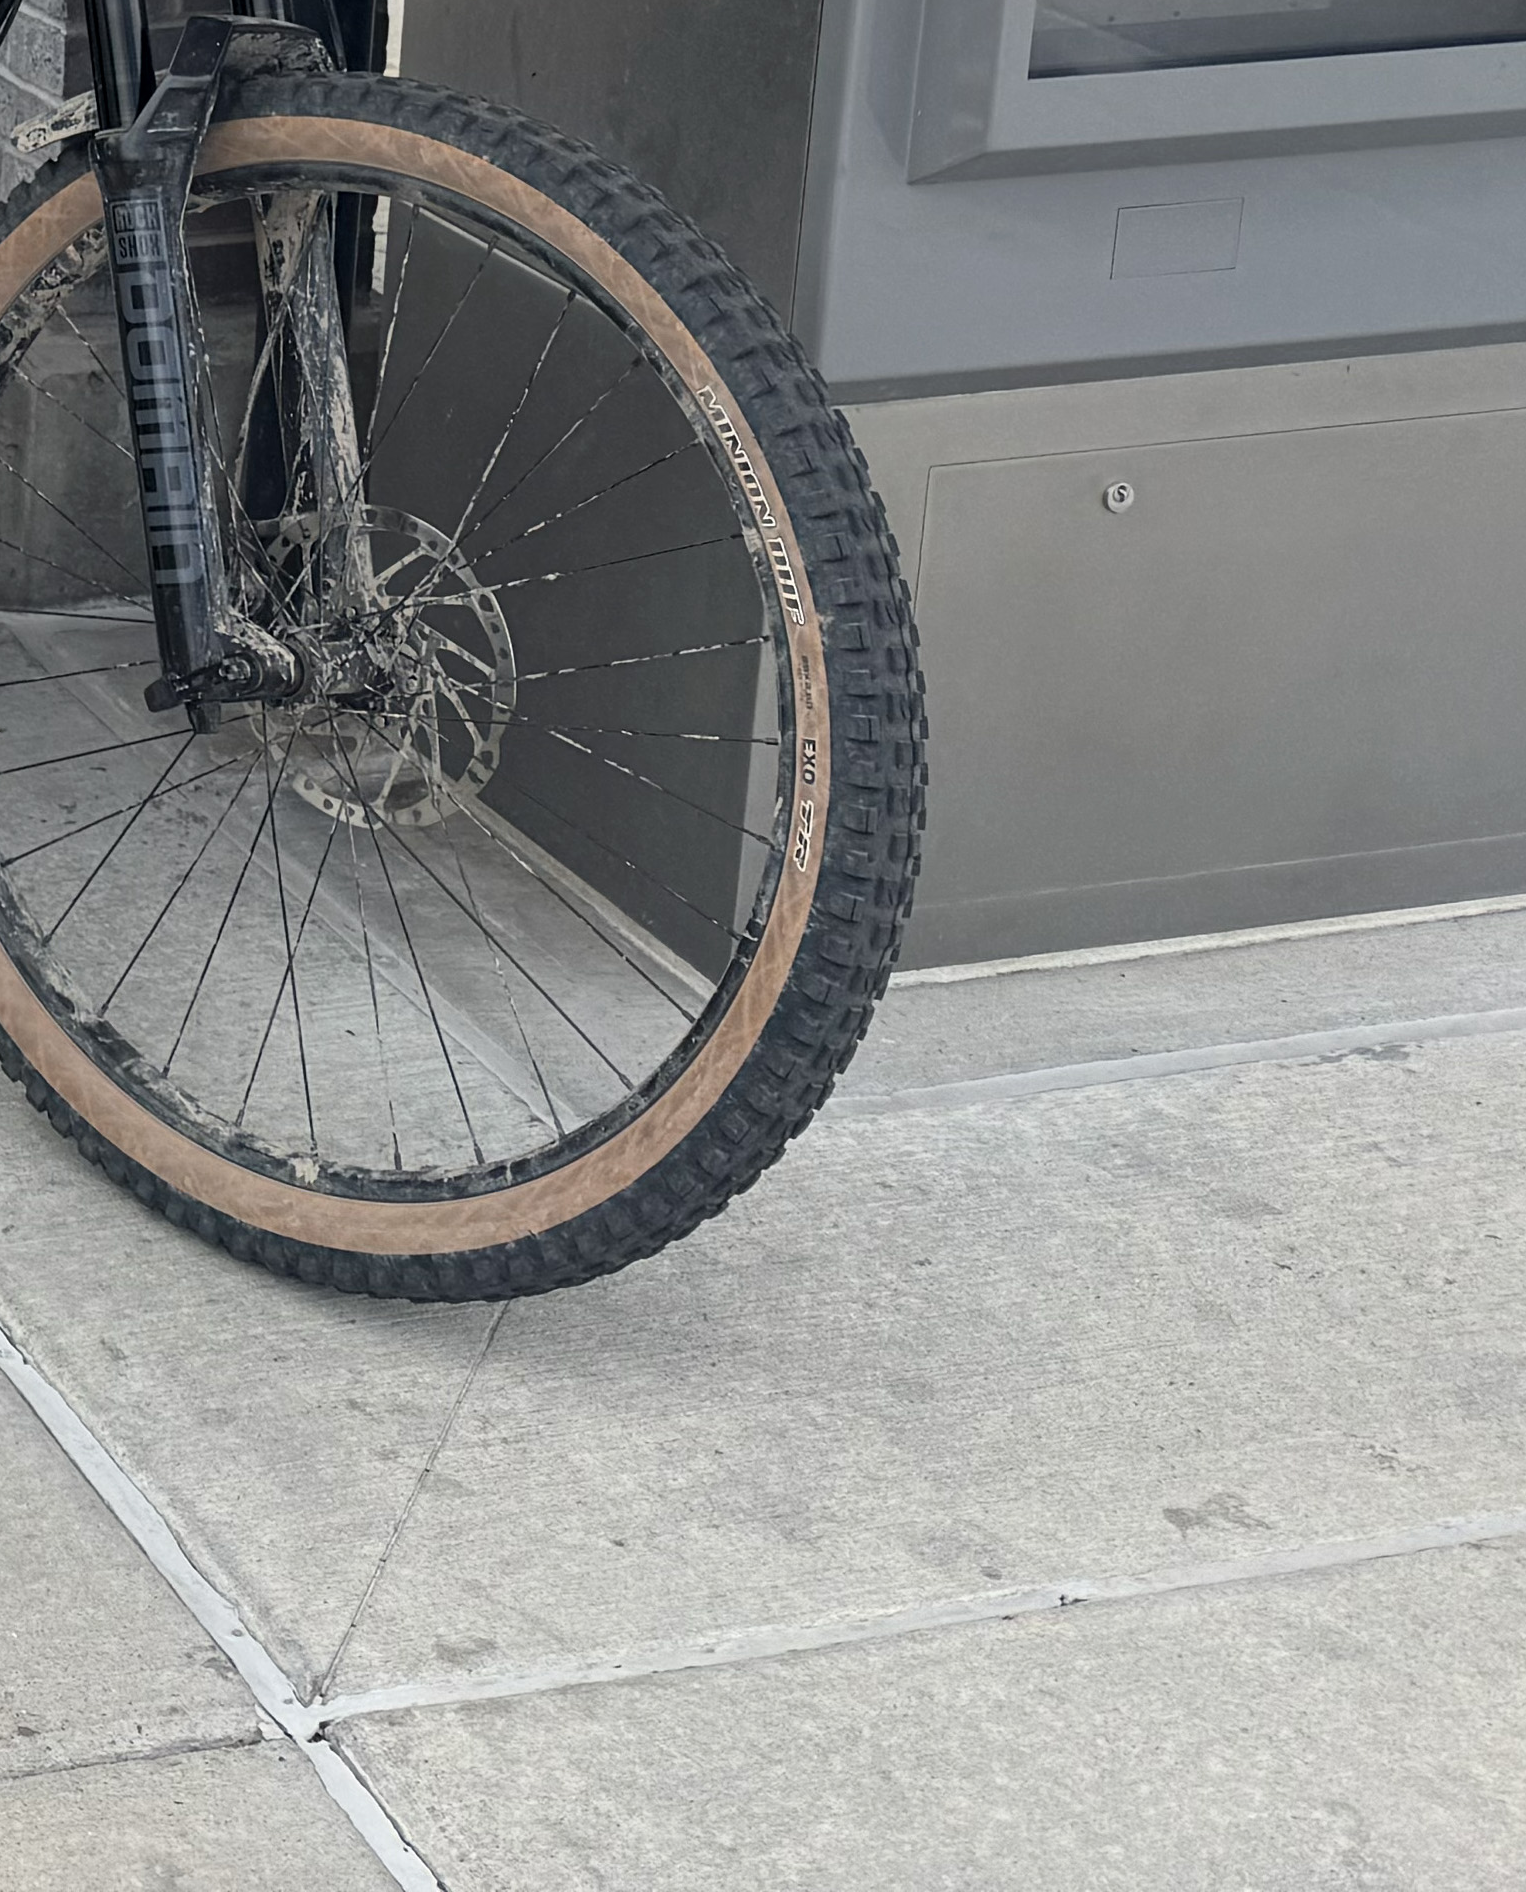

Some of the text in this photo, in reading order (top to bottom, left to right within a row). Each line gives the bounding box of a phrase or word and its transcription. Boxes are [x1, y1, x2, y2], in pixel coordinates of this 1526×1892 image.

[114, 202, 161, 232] ROCK
[118, 233, 161, 259] SHOX
[696, 384, 777, 528] MINION
[802, 737, 817, 786] EXO
